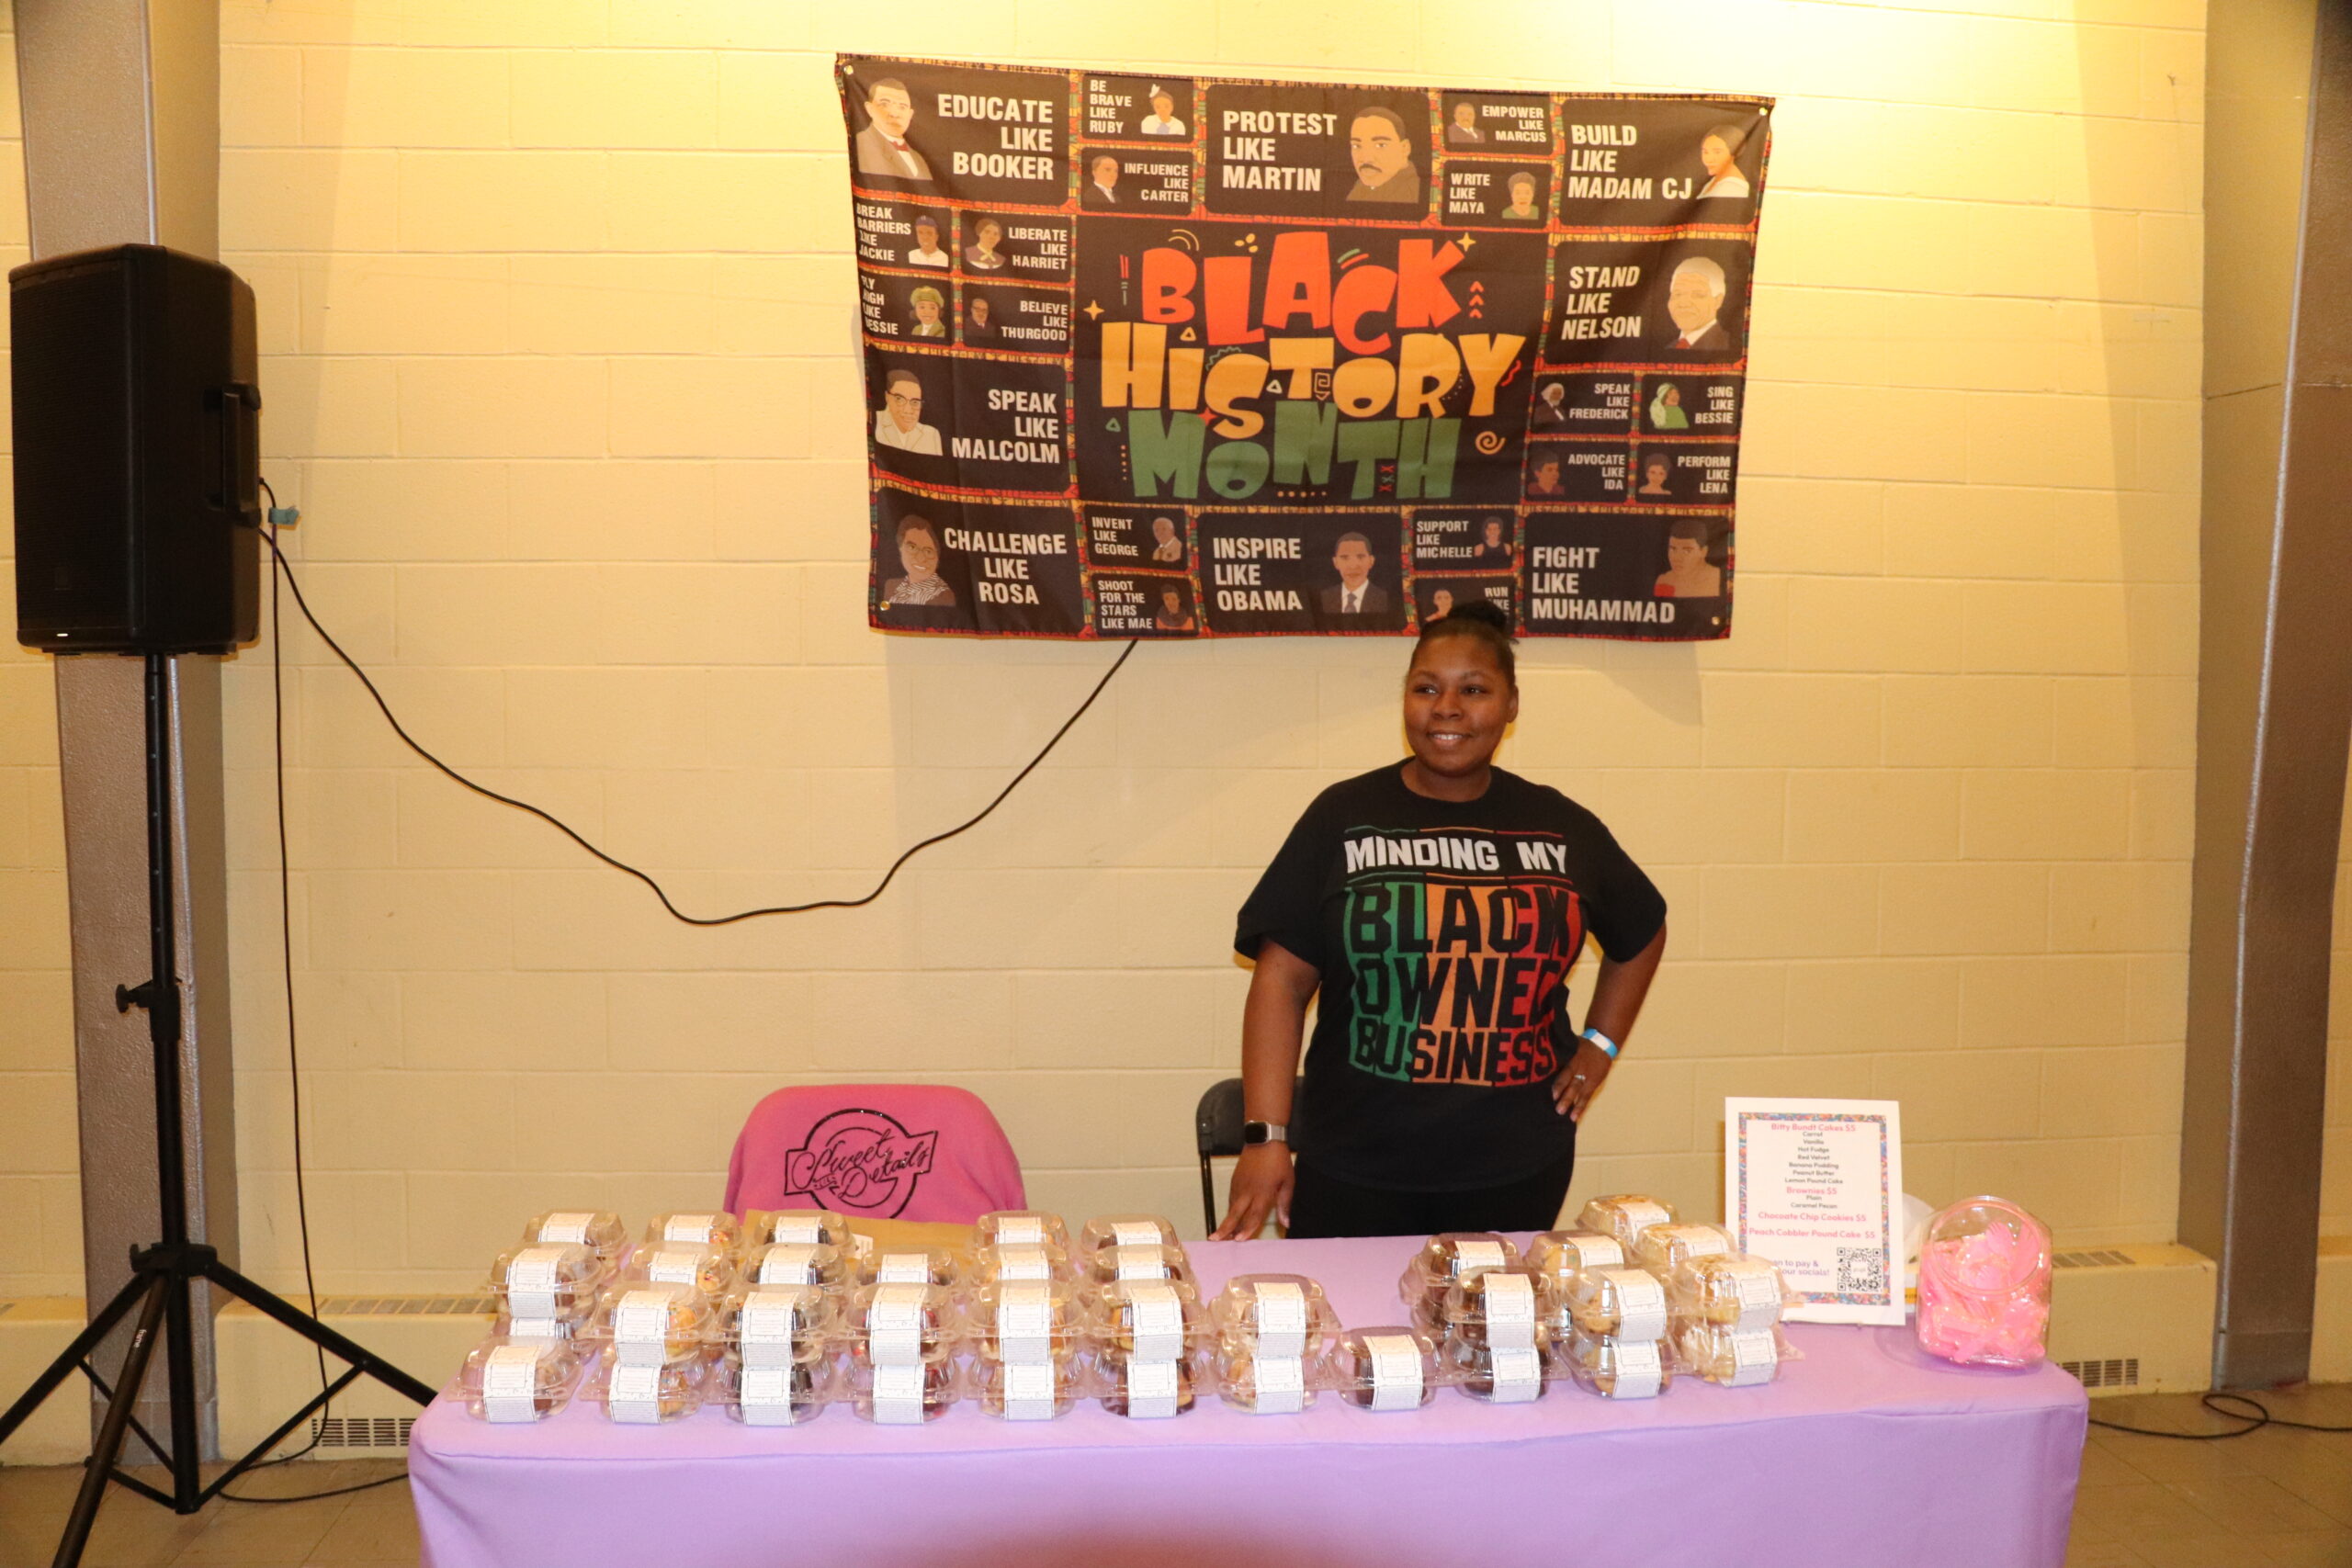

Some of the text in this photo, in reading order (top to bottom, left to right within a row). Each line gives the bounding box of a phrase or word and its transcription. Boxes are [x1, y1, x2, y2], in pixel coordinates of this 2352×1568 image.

[1090, 80, 1106, 92] BE
[1090, 94, 1132, 107] BRAVE
[937, 94, 1053, 123] EDUCATE
[1090, 107, 1115, 118] LIKE
[1482, 105, 1544, 118] EMPOWER
[1090, 120, 1124, 133] RUBY
[1223, 110, 1337, 135] PROTEST
[1519, 119, 1544, 130] LIKE
[1001, 127, 1053, 152] LIKE
[1496, 130, 1546, 142] MARCUS
[1571, 124, 1637, 146] BUILD
[1223, 137, 1275, 161] LIKE
[953, 152, 1054, 180] BOOKER
[1570, 150, 1617, 172] LIKE
[1125, 163, 1189, 176] INFLUENCE
[1164, 177, 1189, 189] LIKE
[1223, 165, 1321, 191] MARTIN
[1451, 173, 1490, 186] WRITE
[1450, 187, 1476, 199] LIKE
[1567, 177, 1692, 199] MADAM CJ
[1141, 189, 1189, 203] CARTER
[856, 203, 892, 220] BREAK
[1449, 201, 1485, 214] MAYA
[857, 218, 911, 235] BARRIERS
[1009, 227, 1068, 242] LIBERATE
[859, 245, 895, 261] JACKIE
[1041, 243, 1067, 256] LIKE
[1012, 254, 1067, 270] HARRIET
[1569, 265, 1640, 288] STAND
[1142, 231, 1465, 355] BLACK
[1020, 300, 1068, 315] BELIEVE
[1566, 293, 1611, 315] LIKE
[1043, 315, 1068, 328] LIKE
[1561, 316, 1642, 340] NELSON
[1001, 326, 1067, 341] THURGOOD
[1101, 322, 1526, 439] HISTORY
[1594, 383, 1631, 395] SPEAK
[1707, 386, 1733, 398] SING
[988, 389, 1057, 413] SPEAK
[1607, 396, 1630, 408] LIKE
[1711, 399, 1735, 411] LIKE
[1569, 408, 1628, 420] FREDERICK
[1694, 412, 1734, 424] BESSIE
[1014, 416, 1058, 440] LIKE
[952, 437, 1060, 464] MALCOLM
[1127, 400, 1462, 500] MONTH
[1567, 454, 1625, 465] ADVOCATE
[1677, 456, 1731, 468] PERFORM
[1601, 467, 1624, 478] LIKE
[1706, 468, 1730, 480] LIKE
[1604, 479, 1623, 491] IDA
[1700, 482, 1728, 494] LENA
[1091, 516, 1133, 529] INVENT
[1417, 521, 1469, 533] SUPPORT
[944, 527, 1068, 555] CHALLENGE
[1093, 530, 1117, 542] LIKE
[1417, 534, 1441, 546] LIKE
[1094, 543, 1138, 556] GEORGE
[1213, 537, 1301, 559] INSPIRE
[1417, 547, 1473, 558] MICHELLE
[1532, 547, 1600, 569] FIGHT
[984, 557, 1029, 581] LIKE
[1215, 564, 1261, 585] LIKE
[1098, 580, 1134, 591] SHOOT
[1532, 572, 1579, 594] LIKE
[978, 581, 1040, 605] ROSA
[1100, 592, 1146, 604] FOR THE
[1484, 586, 1508, 597] RUN
[1216, 590, 1303, 611] OBAMA
[1487, 599, 1510, 610] KE
[1101, 604, 1136, 616] STARS
[1532, 599, 1676, 624] MUHAMMAD
[1102, 617, 1152, 629] LIKE MAE
[1344, 836, 1566, 874] MINDING MY
[1350, 884, 1571, 957] BLACK
[1355, 1018, 1555, 1081] BUSINESS
[1771, 1123, 1790, 1132] Bitty
[792, 1129, 895, 1190] Sweet
[838, 1141, 929, 1198] Details
[1786, 1186, 1838, 1195] Brownies $5
[1800, 1213, 1818, 1222] Chip
[1821, 1213, 1854, 1222] Cookies
[1856, 1213, 1866, 1223] $5
[1749, 1227, 1775, 1236] Peach
[1776, 1229, 1810, 1237] Cobbler
[1811, 1230, 1838, 1238] Pound
[1865, 1230, 1875, 1239] $5
[1795, 1260, 1811, 1269] pay
[1813, 1259, 1819, 1268] &
[1798, 1268, 1831, 1276] socials!
